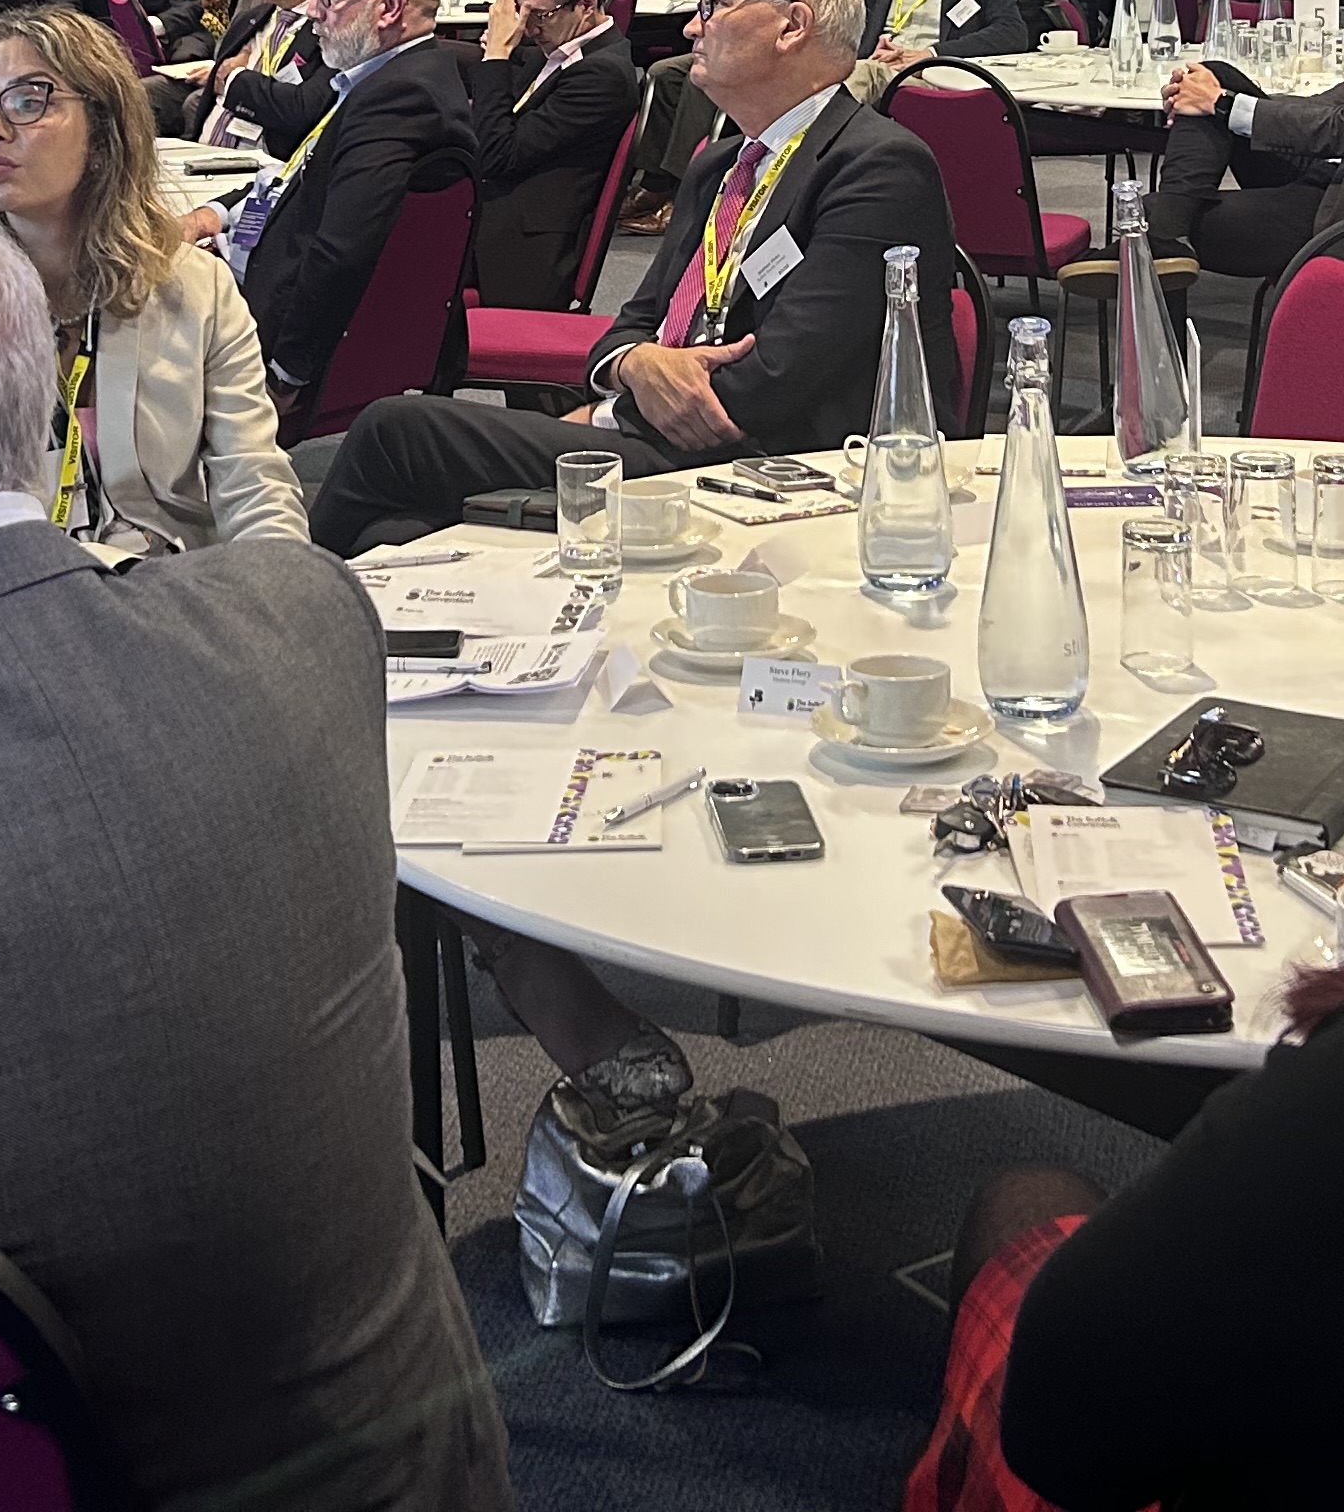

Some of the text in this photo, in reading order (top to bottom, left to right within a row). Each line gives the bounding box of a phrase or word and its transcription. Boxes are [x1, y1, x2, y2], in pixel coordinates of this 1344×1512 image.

[1314, 7, 1325, 28] 5
[772, 144, 793, 172] VISITOR
[747, 183, 769, 212] VISITOR
[68, 425, 79, 466] VISITOR
[55, 490, 70, 524] VISITO
[768, 666, 790, 676] Steve
